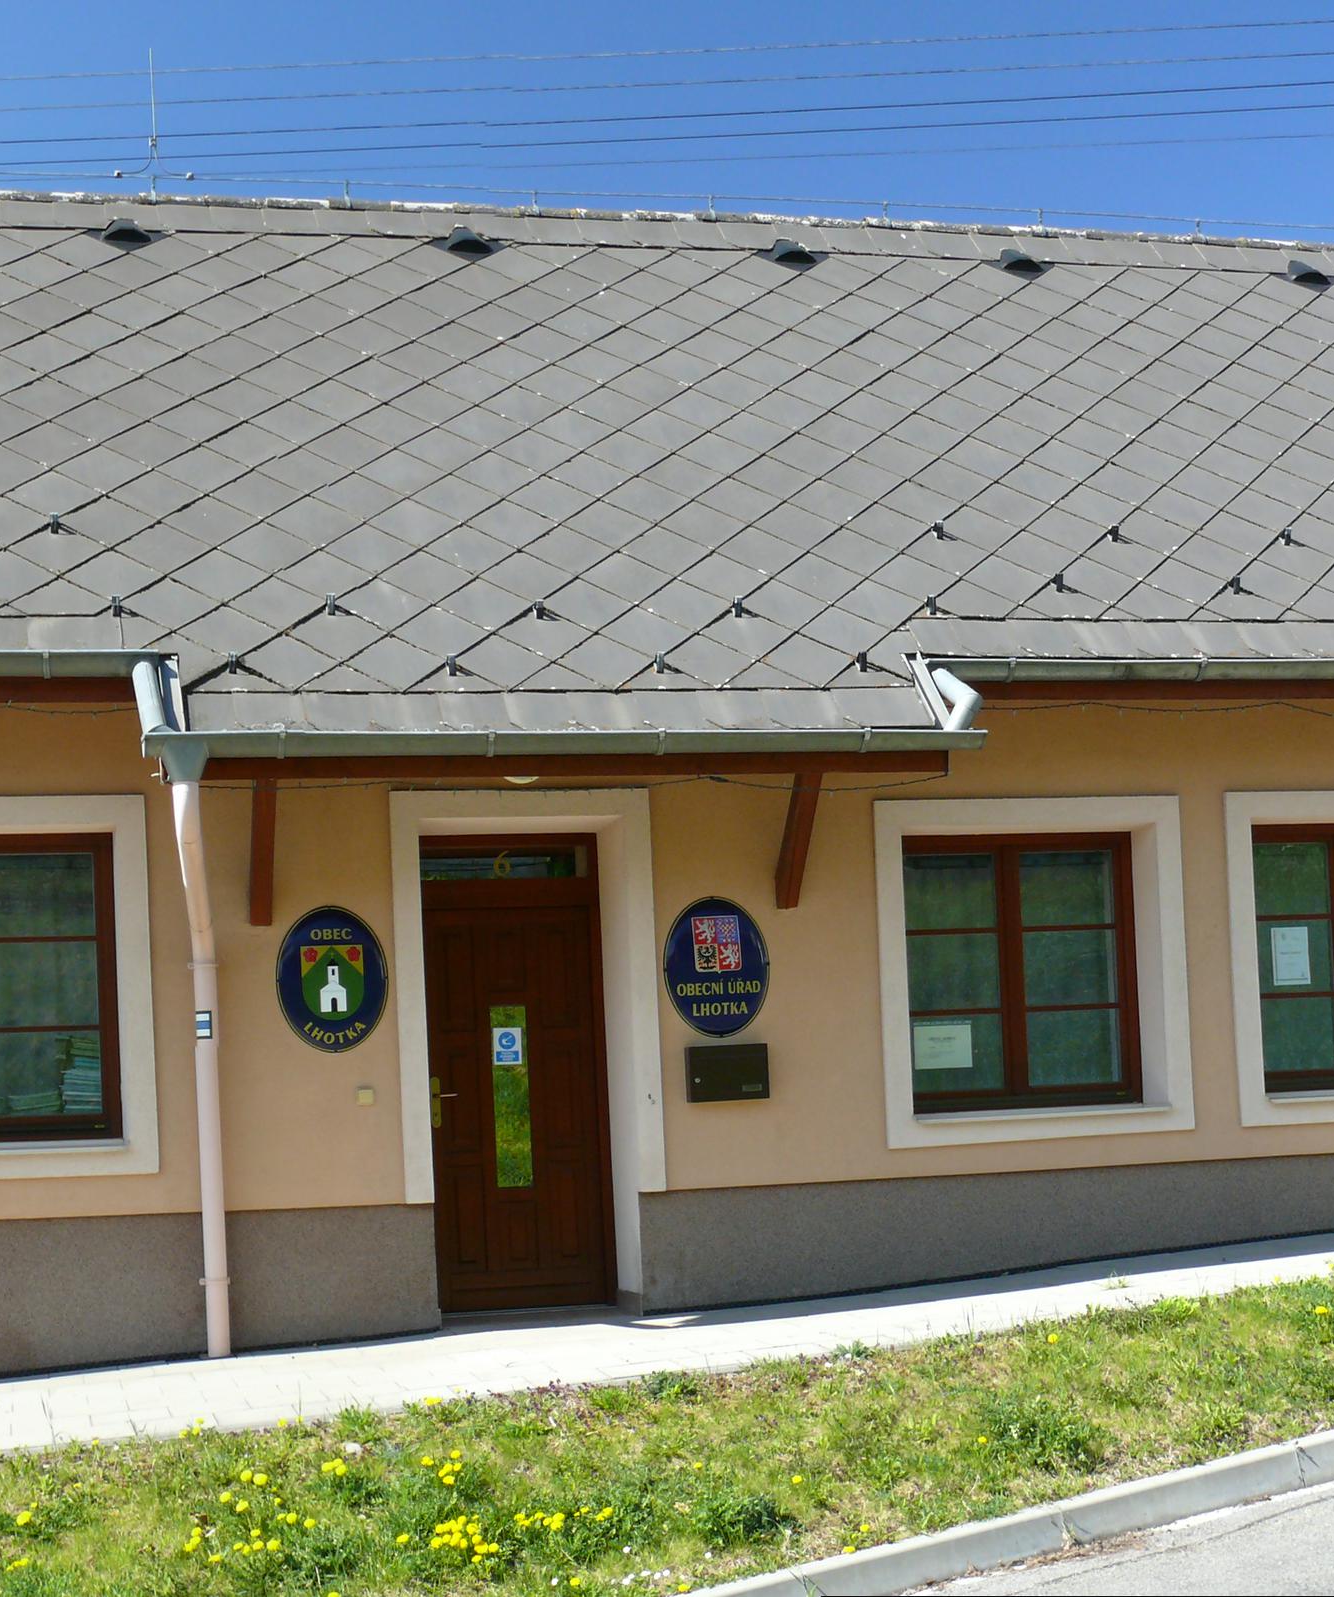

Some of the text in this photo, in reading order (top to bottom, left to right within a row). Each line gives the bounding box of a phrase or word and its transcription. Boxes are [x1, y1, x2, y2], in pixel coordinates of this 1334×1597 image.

[493, 850, 510, 877] 6
[310, 928, 353, 941] OBEC
[676, 977, 761, 997] OBECNÍ ÚŘAD
[692, 1001, 748, 1017] LHOTKA
[303, 1021, 367, 1044] LHOTKA
